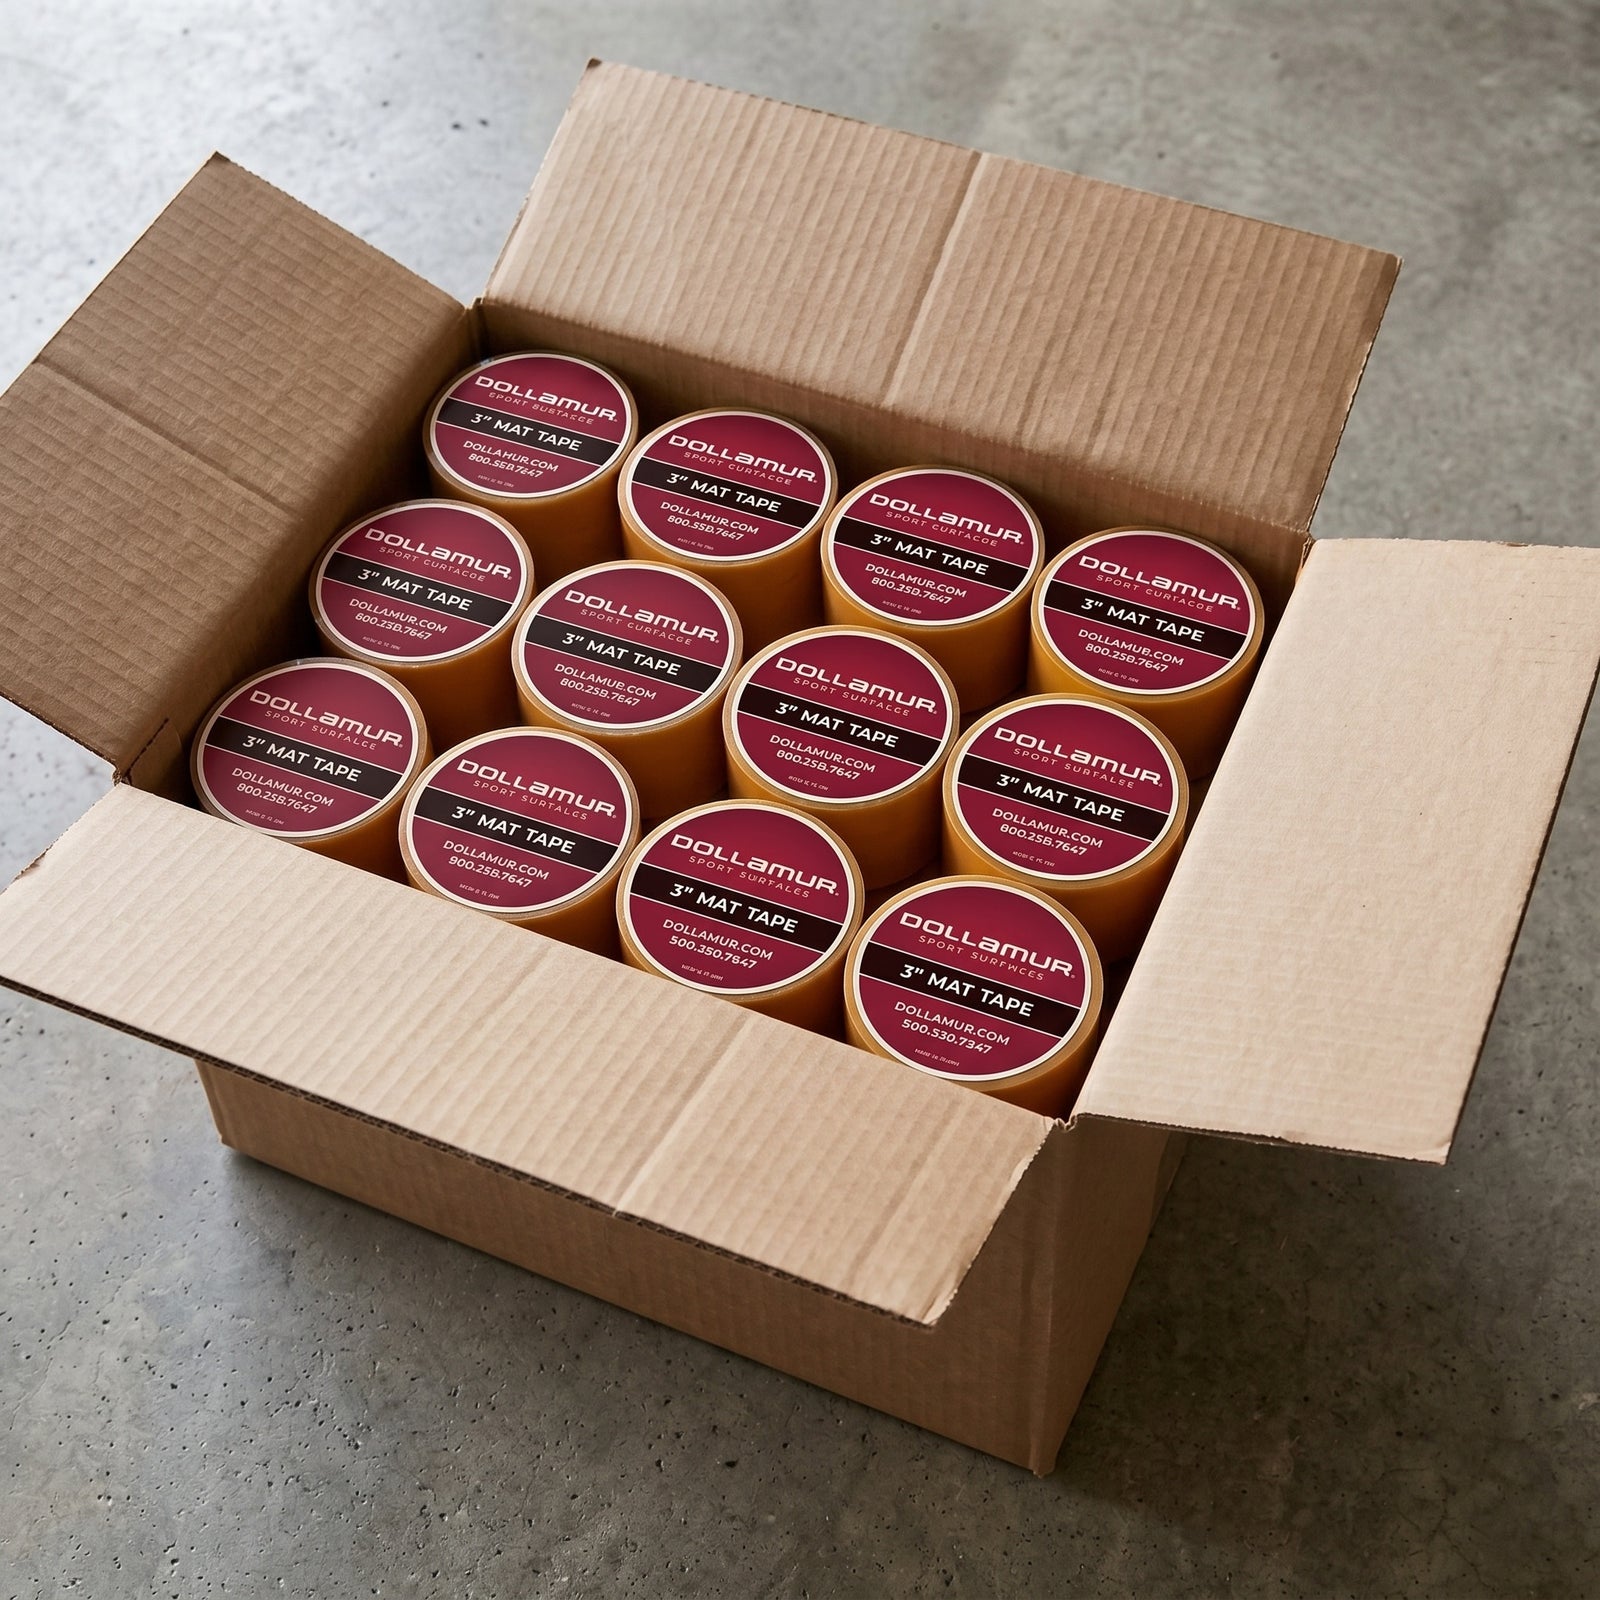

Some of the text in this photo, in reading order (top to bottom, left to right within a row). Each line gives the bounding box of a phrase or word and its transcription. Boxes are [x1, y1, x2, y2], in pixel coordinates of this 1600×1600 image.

[471, 413, 582, 451] 3" MAT TAPE
[684, 452, 723, 465] SPORT
[667, 472, 781, 512] 3" MAT TAPE
[886, 511, 926, 526] SPORT
[379, 546, 418, 562] SPORT
[870, 534, 989, 575] 3" MAT TAPE
[358, 568, 472, 610] 3" MAT TAPE
[865, 563, 967, 598] DOLLAMUR.COM
[1096, 575, 1139, 590] SPORT
[349, 598, 448, 633] DOLLAMUR.COM
[581, 609, 621, 625] SPORT
[1081, 598, 1205, 642] 3" MAT TAPE
[562, 632, 681, 675] 3" MAT TAPE
[794, 677, 836, 693] SPORT
[265, 711, 305, 727] SPORT
[775, 702, 899, 747] 3" MAT TAPE
[242, 735, 361, 782] 3" MAT TAPE
[770, 734, 876, 772] DOLLAMUR.COM
[1014, 748, 1058, 765] SPORT
[232, 768, 334, 806] DOLLAMUR.COM
[473, 781, 515, 797] SPORT
[997, 774, 1125, 822] 3" MAT TAPE
[451, 806, 576, 854] 3" MAT TAPE
[992, 808, 1103, 848] DOLLAMUR.COM
[443, 840, 549, 879] DOLLAMUR.COM
[689, 856, 733, 873] SPORT
[670, 884, 798, 933] 3" MAT TAPE
[663, 919, 773, 960] DOLLAMUR.COM
[919, 936, 963, 954] SPORT
[900, 964, 1034, 1016] 3" MAT TAPE
[894, 1002, 1010, 1045] DOLLAMUR.COM
